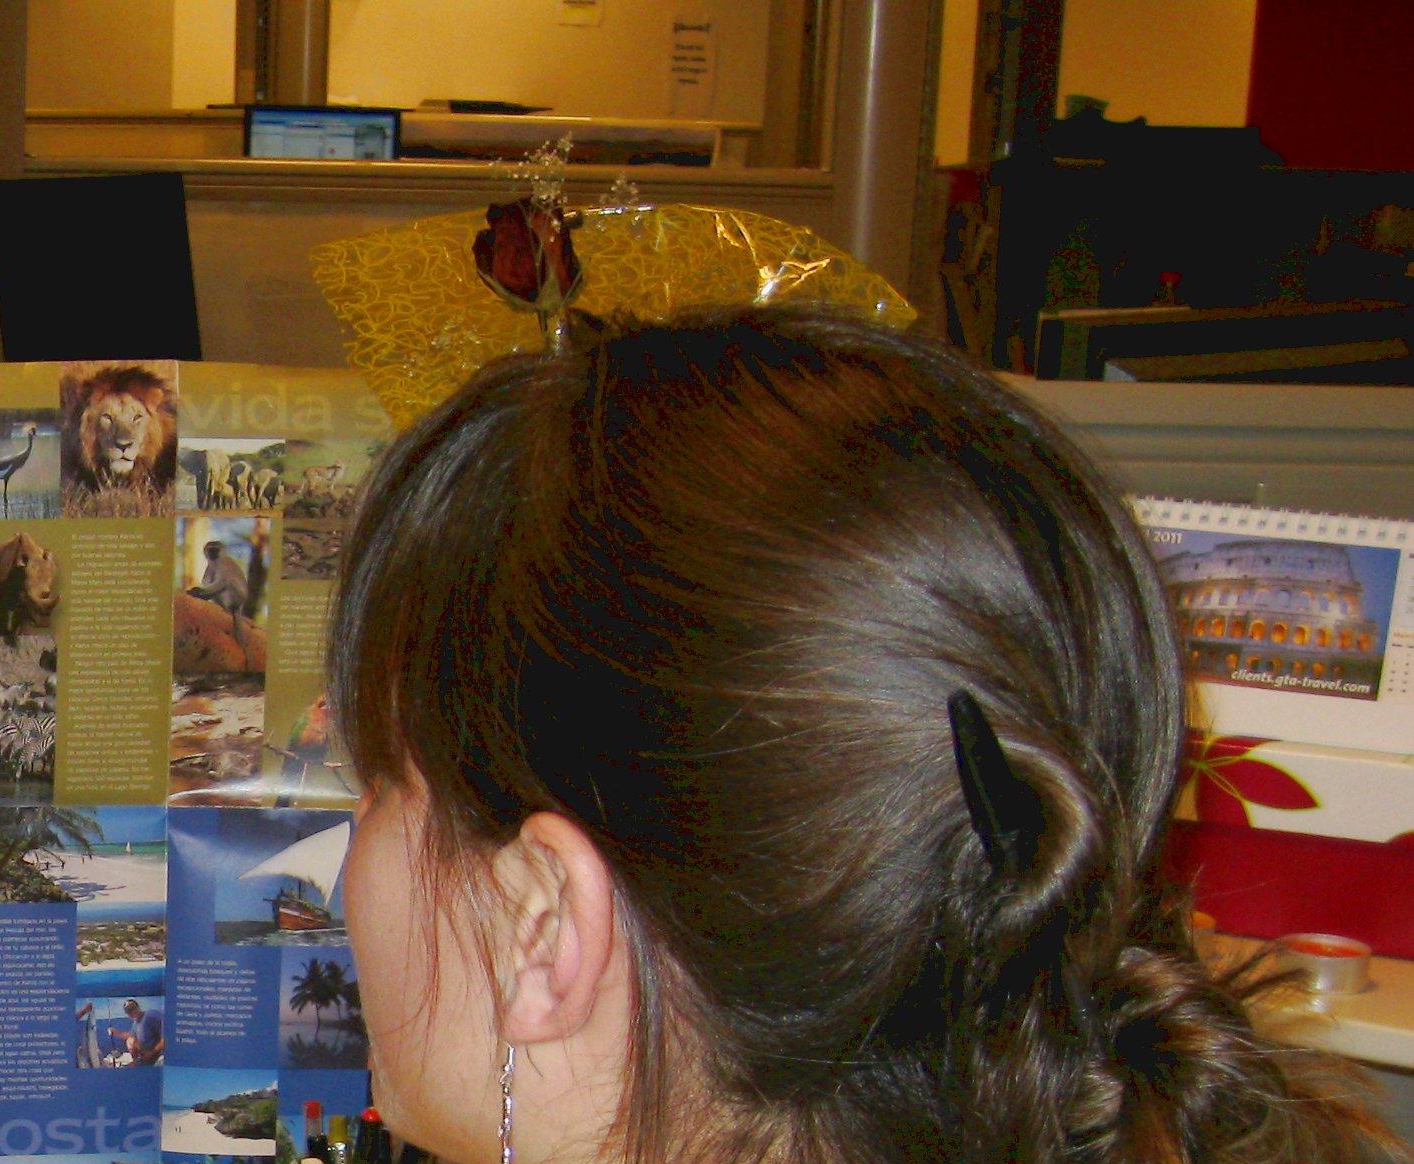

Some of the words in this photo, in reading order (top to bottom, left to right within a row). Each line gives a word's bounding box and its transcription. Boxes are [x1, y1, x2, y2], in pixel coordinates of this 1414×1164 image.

[183, 379, 335, 434] vida
[1152, 531, 1183, 545] 2011
[1231, 667, 1370, 695] clients.gta-travel.com
